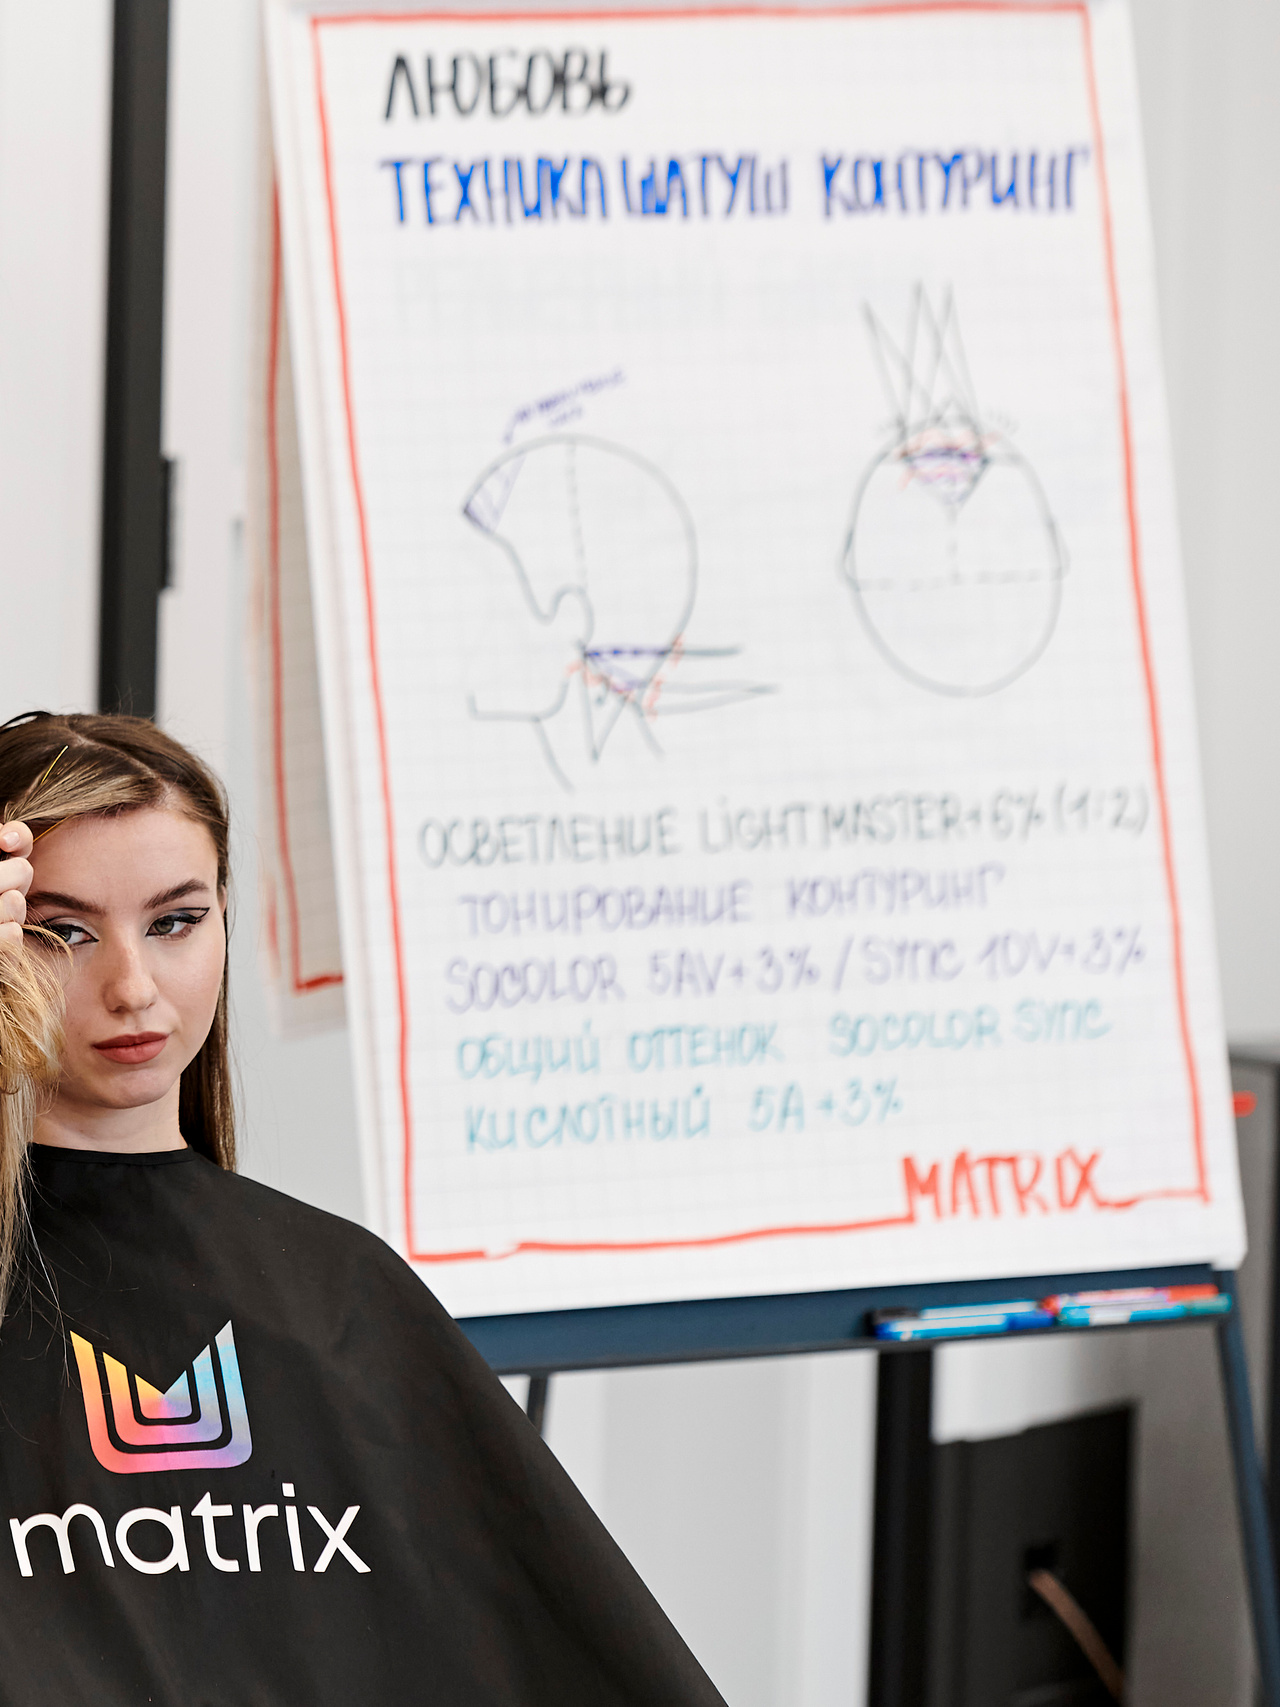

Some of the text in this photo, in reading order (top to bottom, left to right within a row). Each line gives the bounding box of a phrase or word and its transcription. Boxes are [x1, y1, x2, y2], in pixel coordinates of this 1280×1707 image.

[383, 49, 633, 121] ЛЮБОВЬ
[819, 147, 1091, 220] КОНТУРИНГ
[419, 806, 682, 867] ОСВЕТЛЕНИЕ
[458, 861, 1006, 937] ТОНИРОВАНИЕ КОНТУРИНГ
[444, 954, 626, 1014] SOCOLOR
[456, 1019, 600, 1083] ОБЩИЙ
[626, 1022, 785, 1072] ОТТЕНОК
[828, 1005, 1001, 1057] SOCOLOR
[466, 1084, 711, 1152] КИСЛОТНЫЙ
[902, 1148, 1104, 1222] MATRIX
[9, 1482, 371, 1577] matrix
